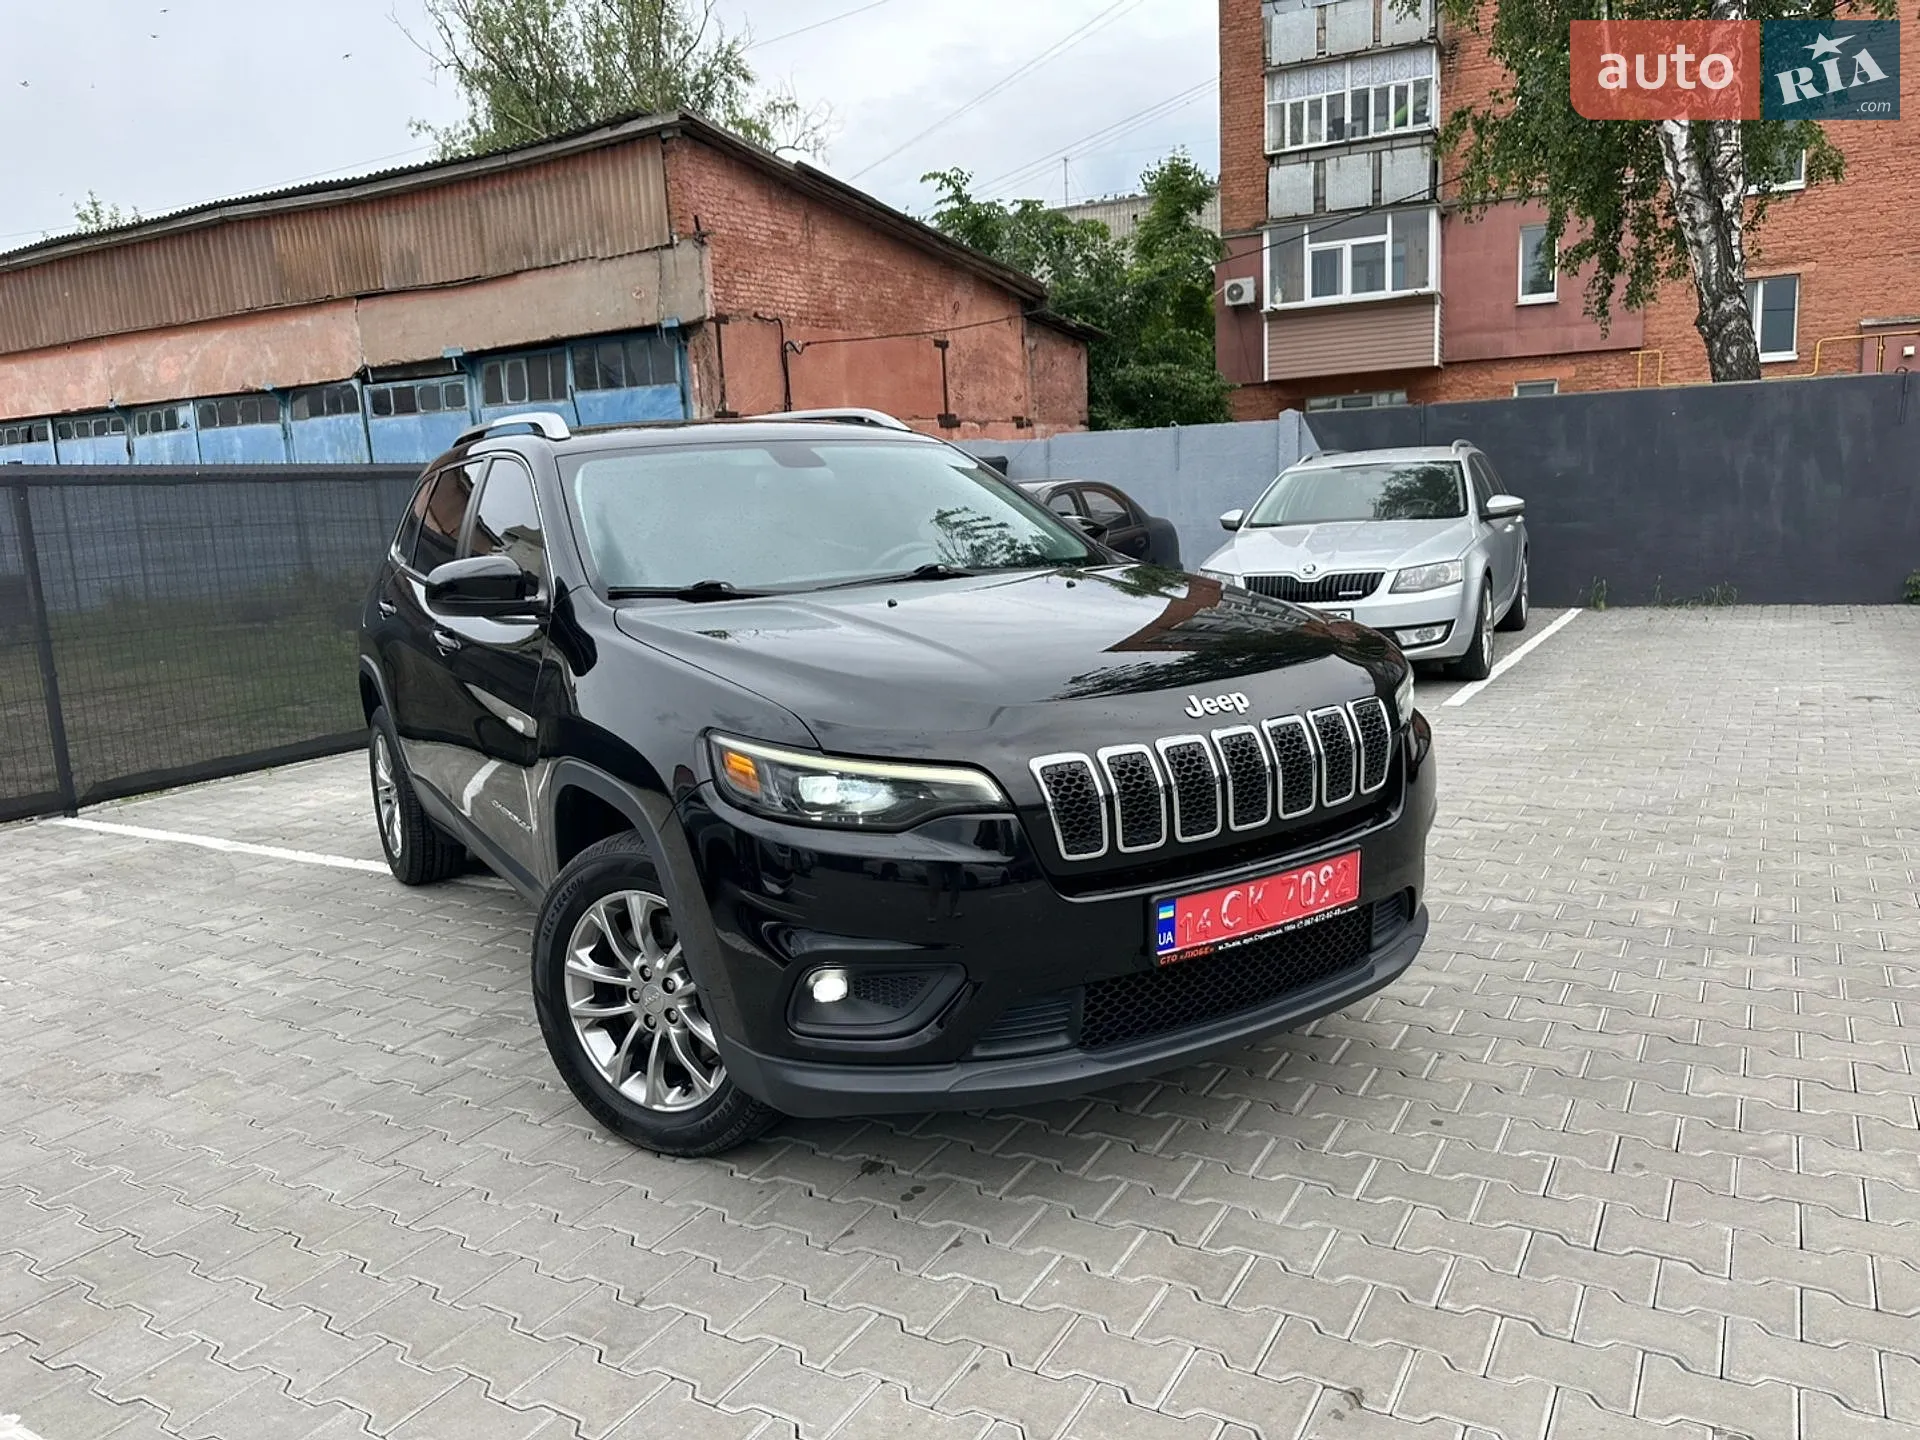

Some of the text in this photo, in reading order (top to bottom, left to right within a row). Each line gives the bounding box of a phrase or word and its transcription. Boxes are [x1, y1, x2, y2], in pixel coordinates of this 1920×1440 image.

[1184, 692, 1250, 717] Jeep
[1221, 882, 1270, 930] CK
[1158, 931, 1174, 946] UA
